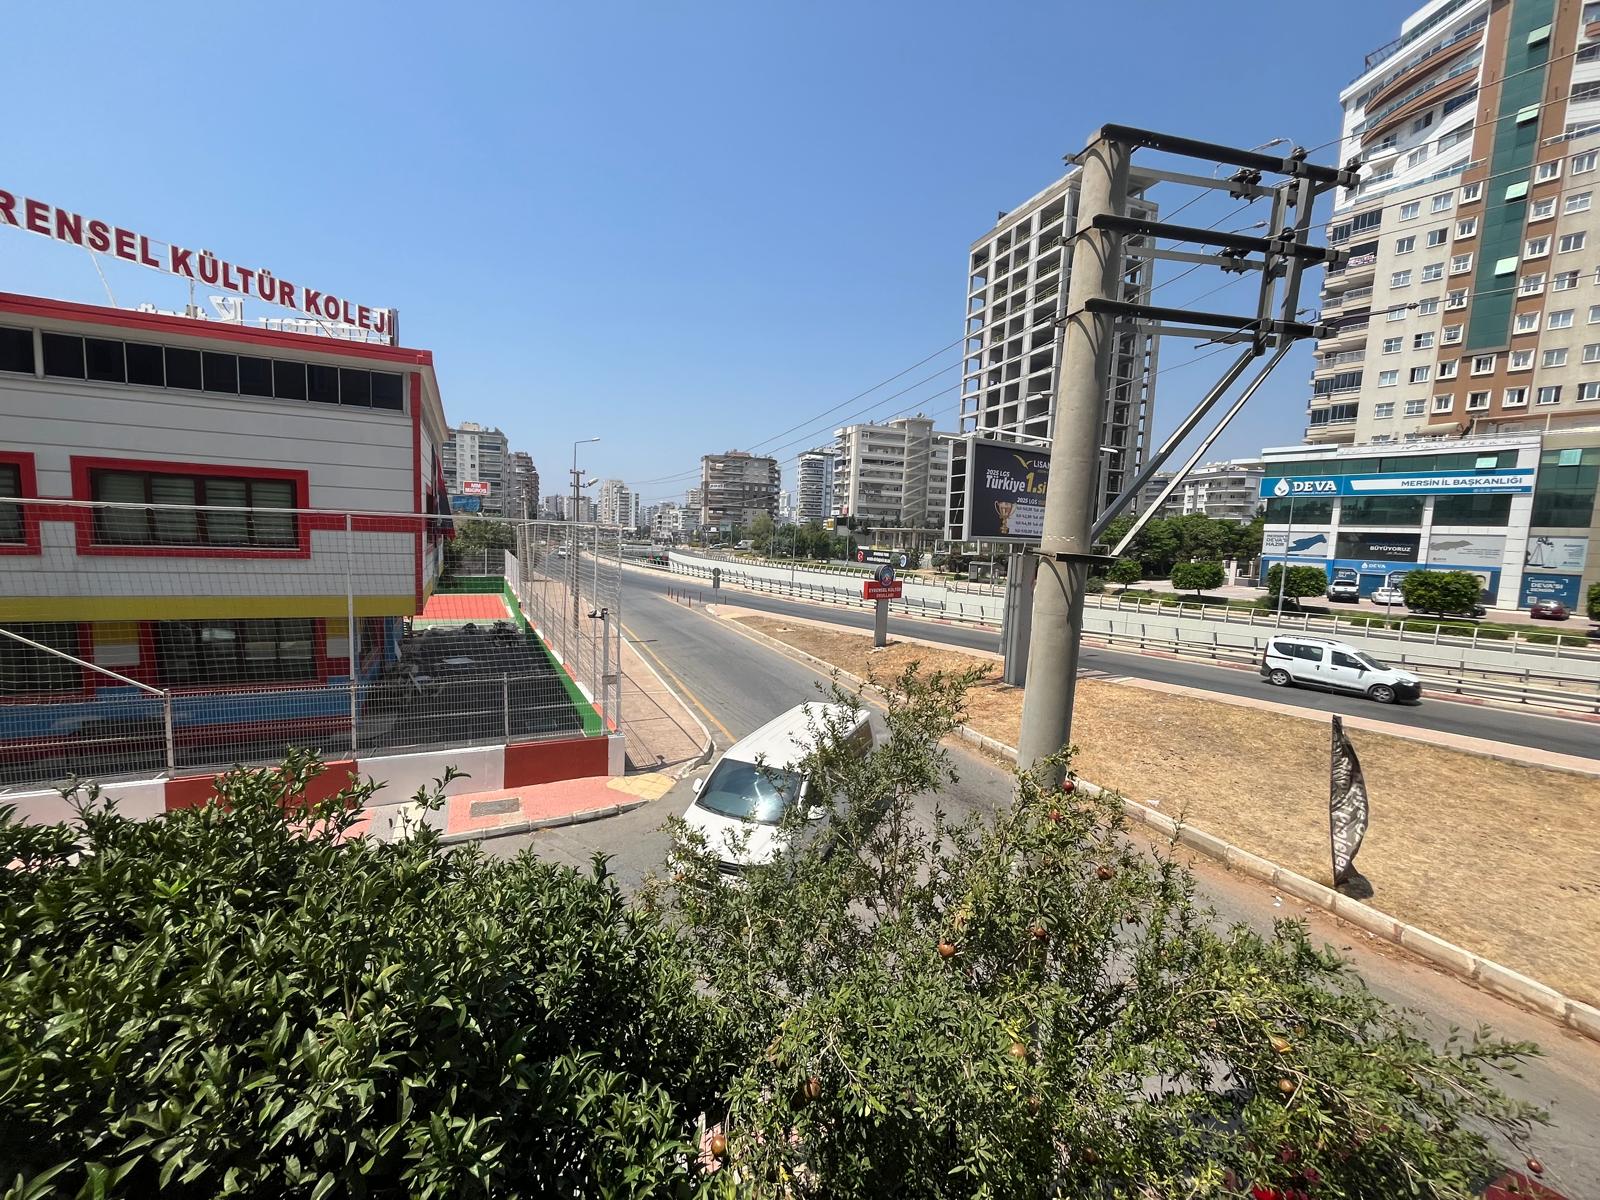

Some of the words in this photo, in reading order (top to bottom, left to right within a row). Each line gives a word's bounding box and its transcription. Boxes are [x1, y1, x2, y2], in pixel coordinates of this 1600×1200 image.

[170, 245, 297, 308] KÜLTÜR
[304, 287, 393, 336] KOLEJİ
[985, 475, 1026, 493] Türkiye
[1293, 481, 1337, 492] DEVA
[1401, 479, 1440, 487] MERSİN
[1441, 478, 1450, 486] İL
[1453, 477, 1523, 487] BAŞKANLIĞI
[1369, 545, 1411, 553] BÜYÜYORUZ
